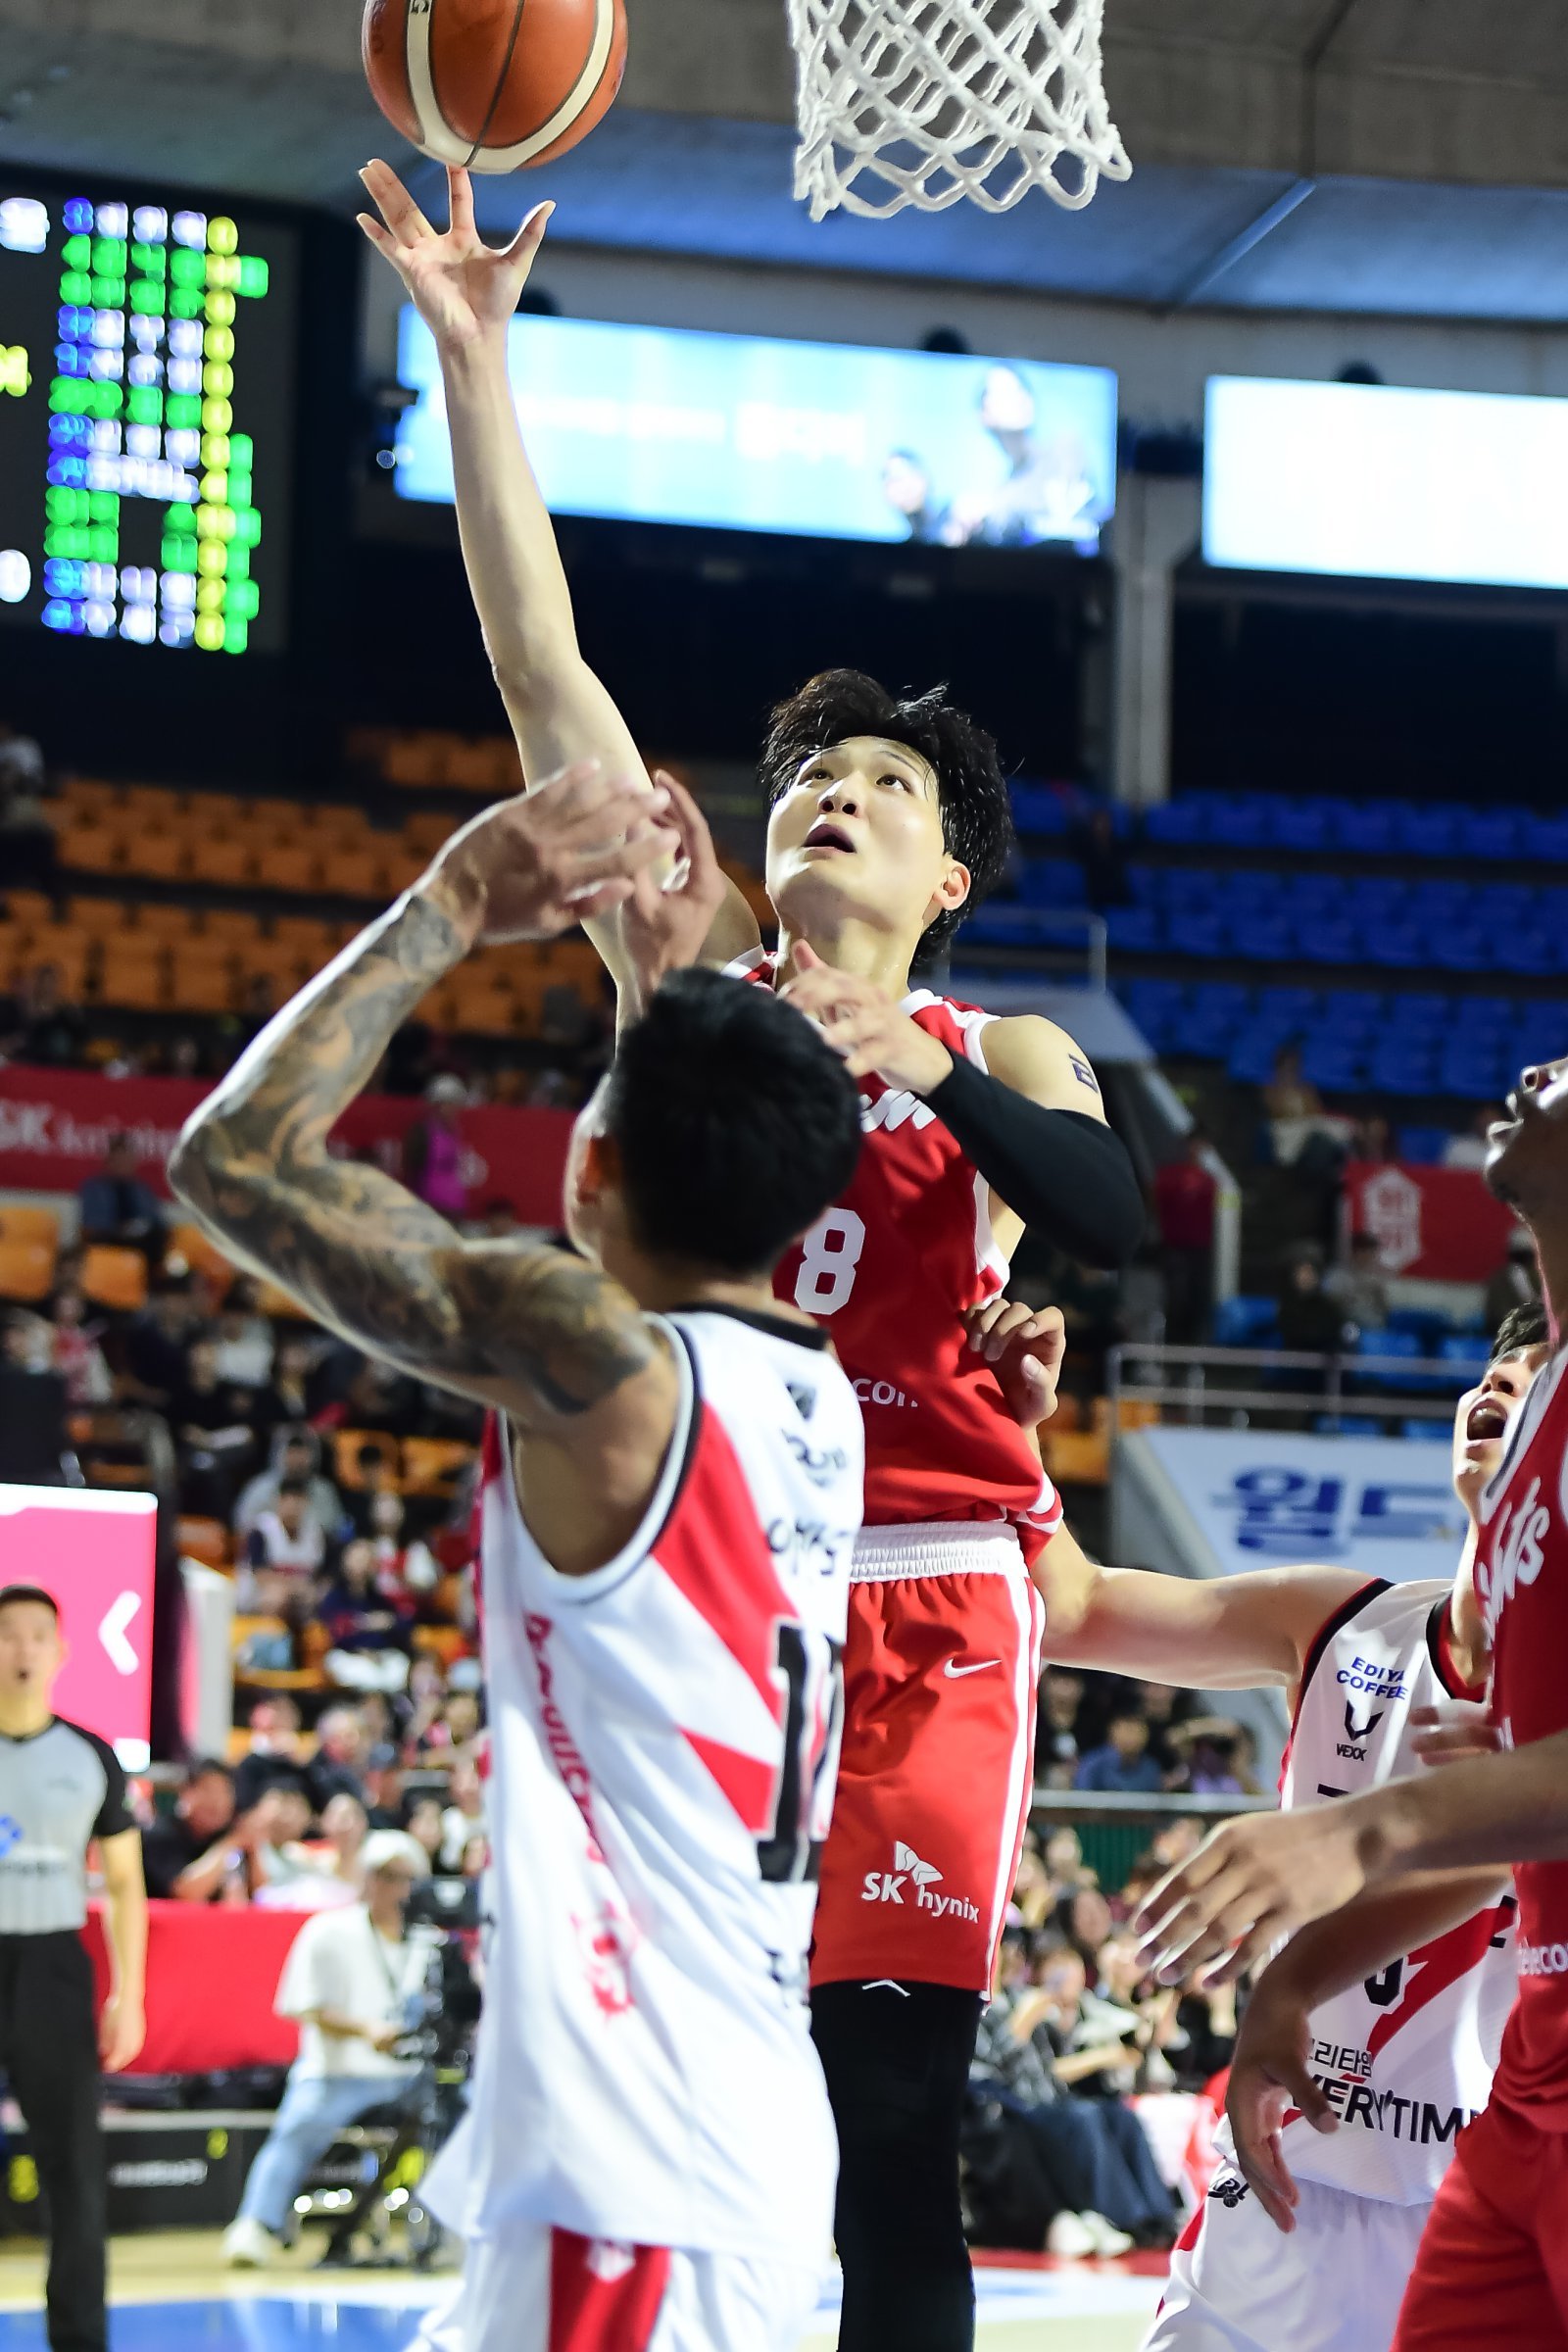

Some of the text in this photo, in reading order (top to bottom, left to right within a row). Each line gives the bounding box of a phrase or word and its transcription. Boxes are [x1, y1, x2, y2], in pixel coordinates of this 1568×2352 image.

[794, 1206, 866, 1316] 8
[1336, 1669, 1409, 1700] COFFEE
[860, 1872, 908, 1905] SK
[917, 1884, 980, 1925] hynix
